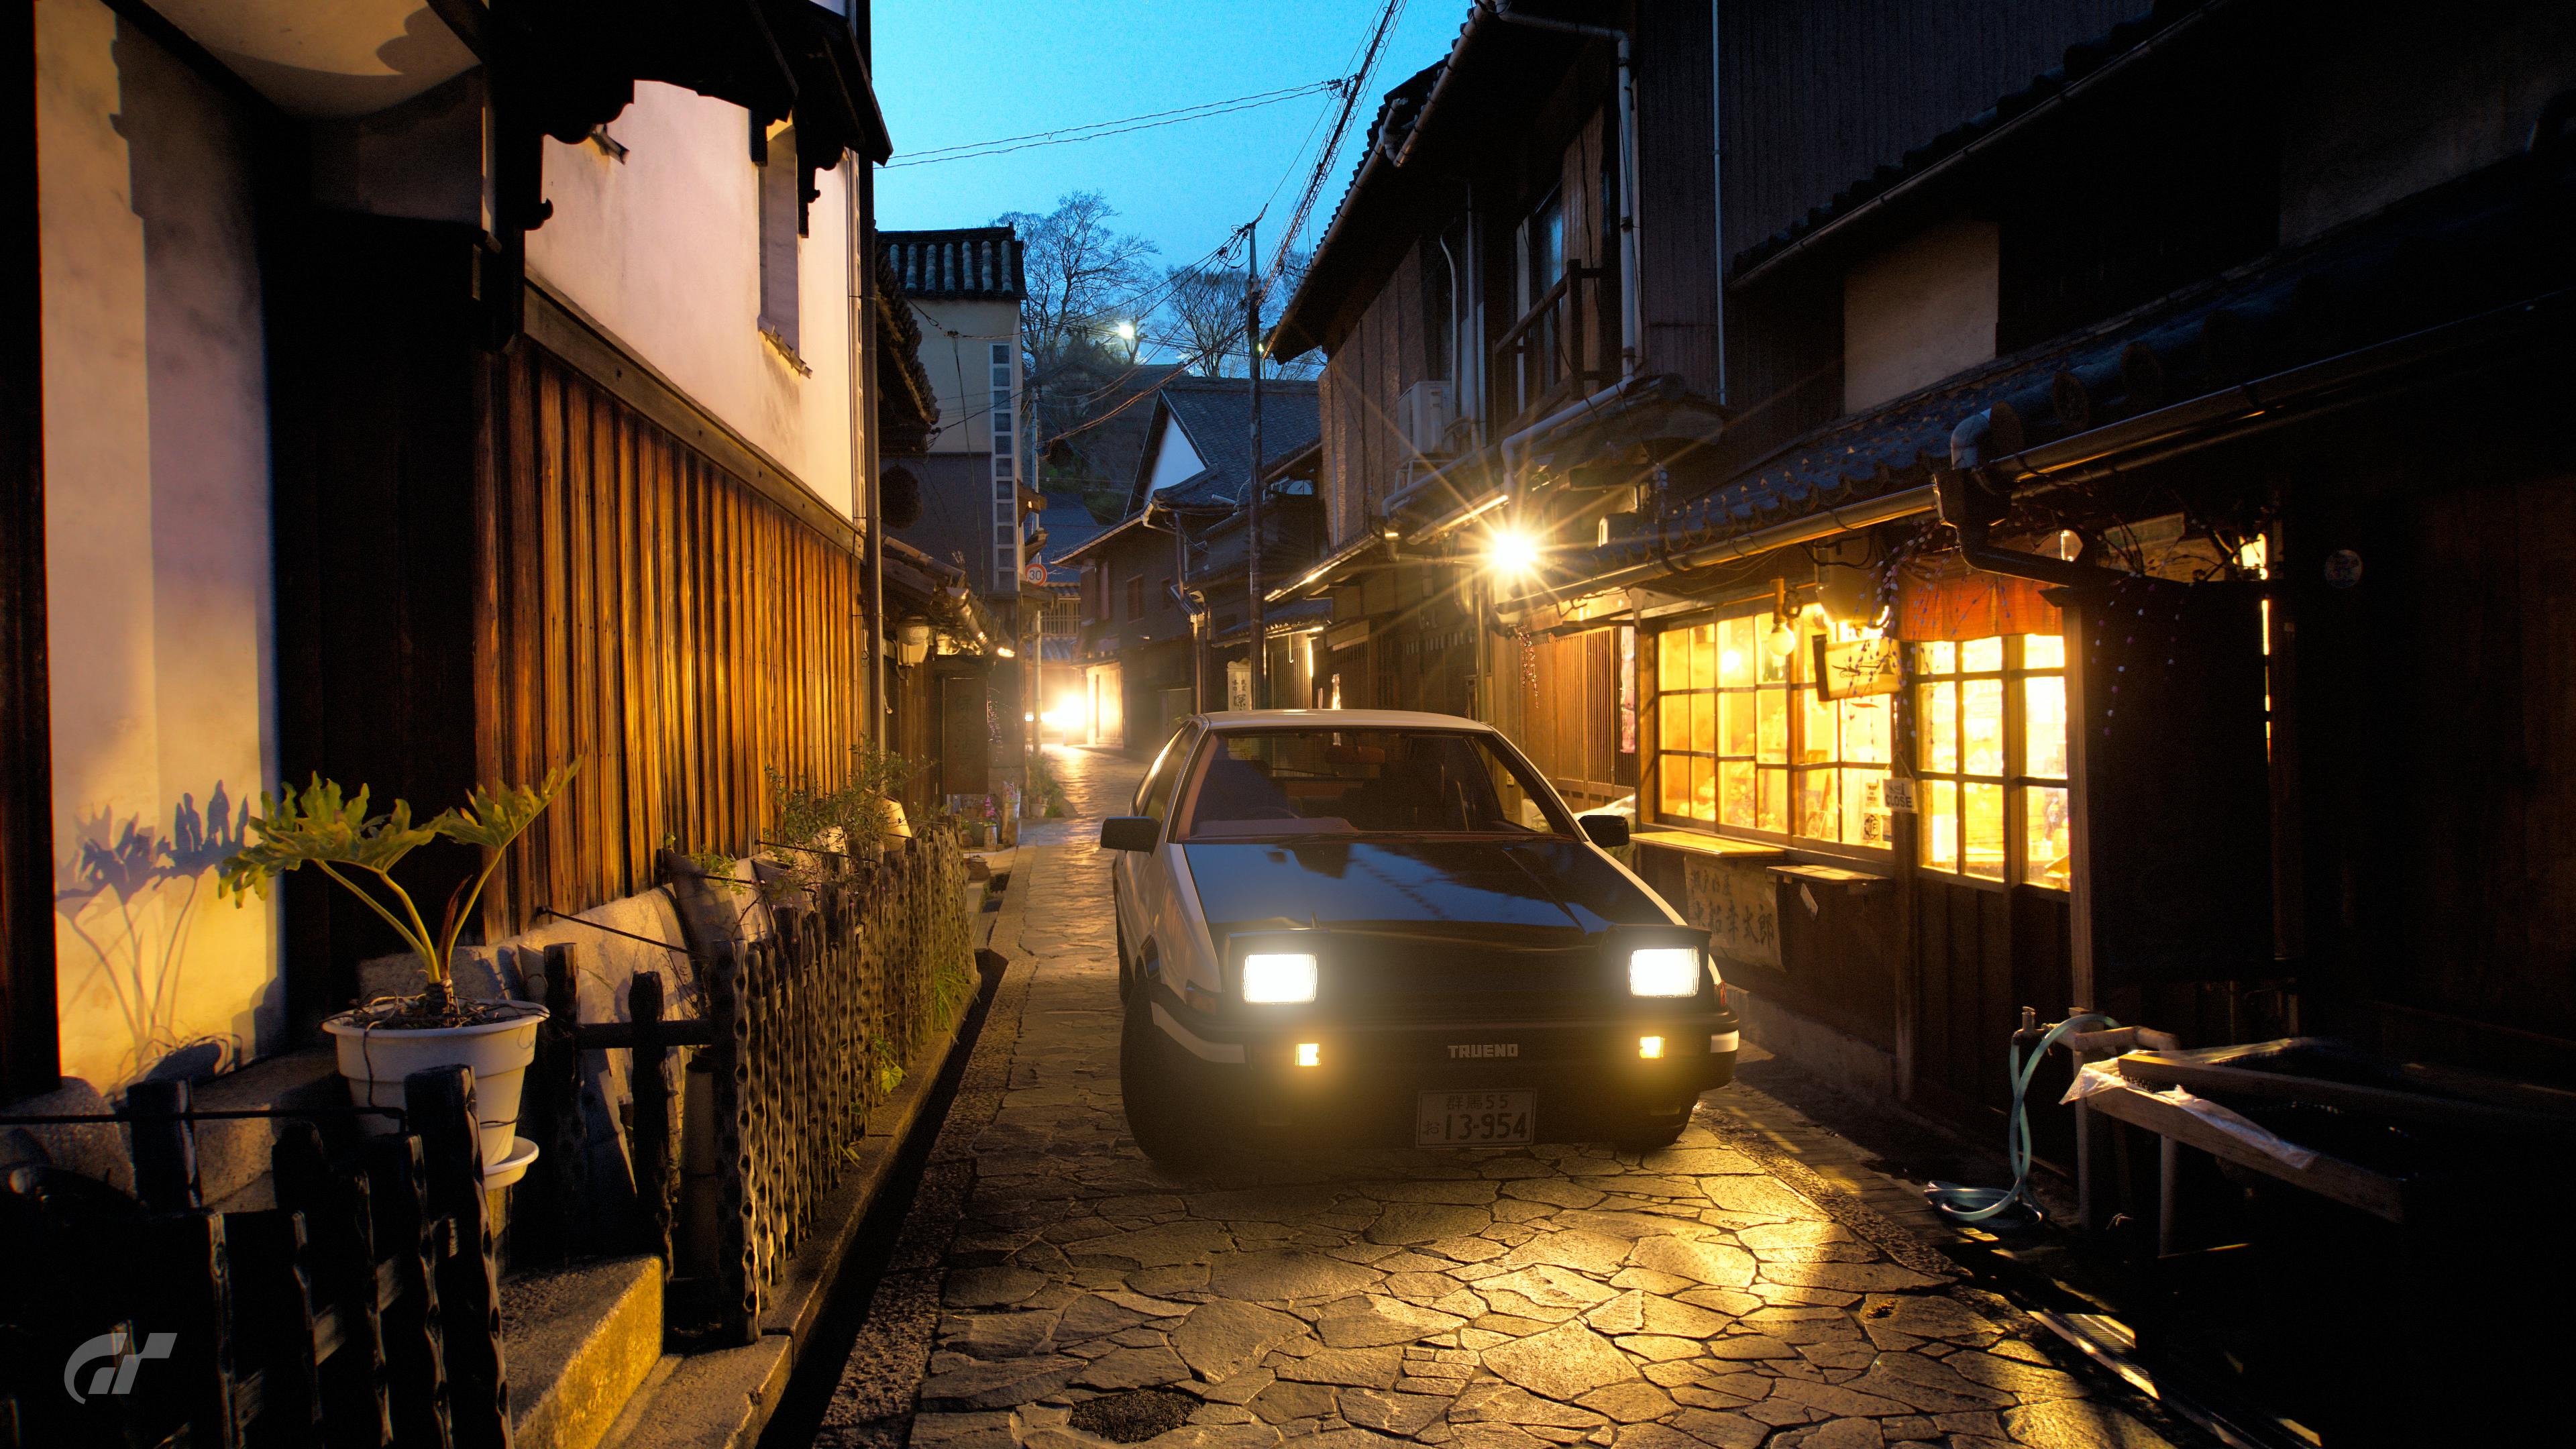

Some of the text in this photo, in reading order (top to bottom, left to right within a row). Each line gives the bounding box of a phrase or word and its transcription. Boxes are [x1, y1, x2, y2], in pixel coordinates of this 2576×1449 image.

[1029, 570, 1042, 580] 30
[1886, 794, 1913, 808] CLOSE
[1447, 1044, 1519, 1059] TRUENO
[1424, 1112, 1527, 1140] お 13-954
